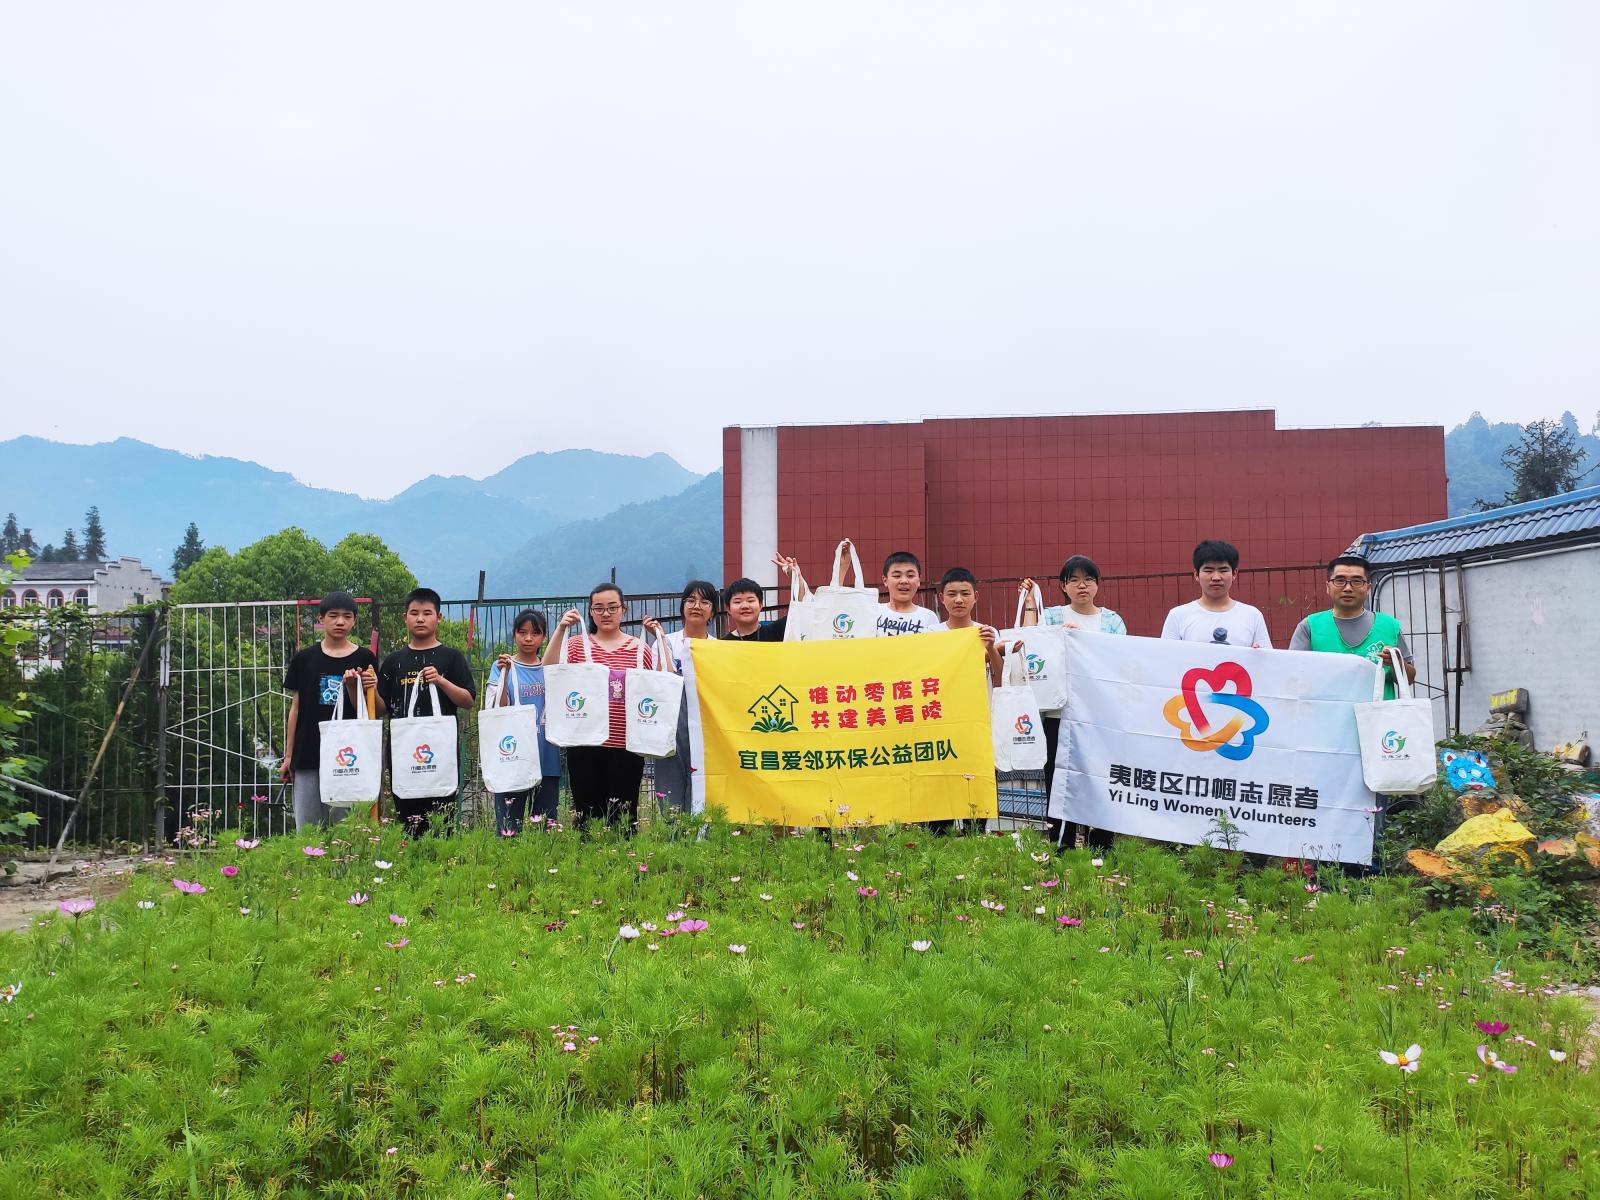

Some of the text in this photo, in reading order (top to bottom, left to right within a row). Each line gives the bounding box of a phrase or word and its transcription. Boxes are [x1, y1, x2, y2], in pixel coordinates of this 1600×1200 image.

[808, 677, 940, 705] 推动零废弃
[810, 700, 942, 729] 共建美夷陵
[738, 739, 958, 771] 宜昌爱邻环保公益团队
[1109, 763, 1319, 810] 夷陵区巾帼志愿者
[1109, 789, 1317, 828] Yi Ling Women Volunteers
